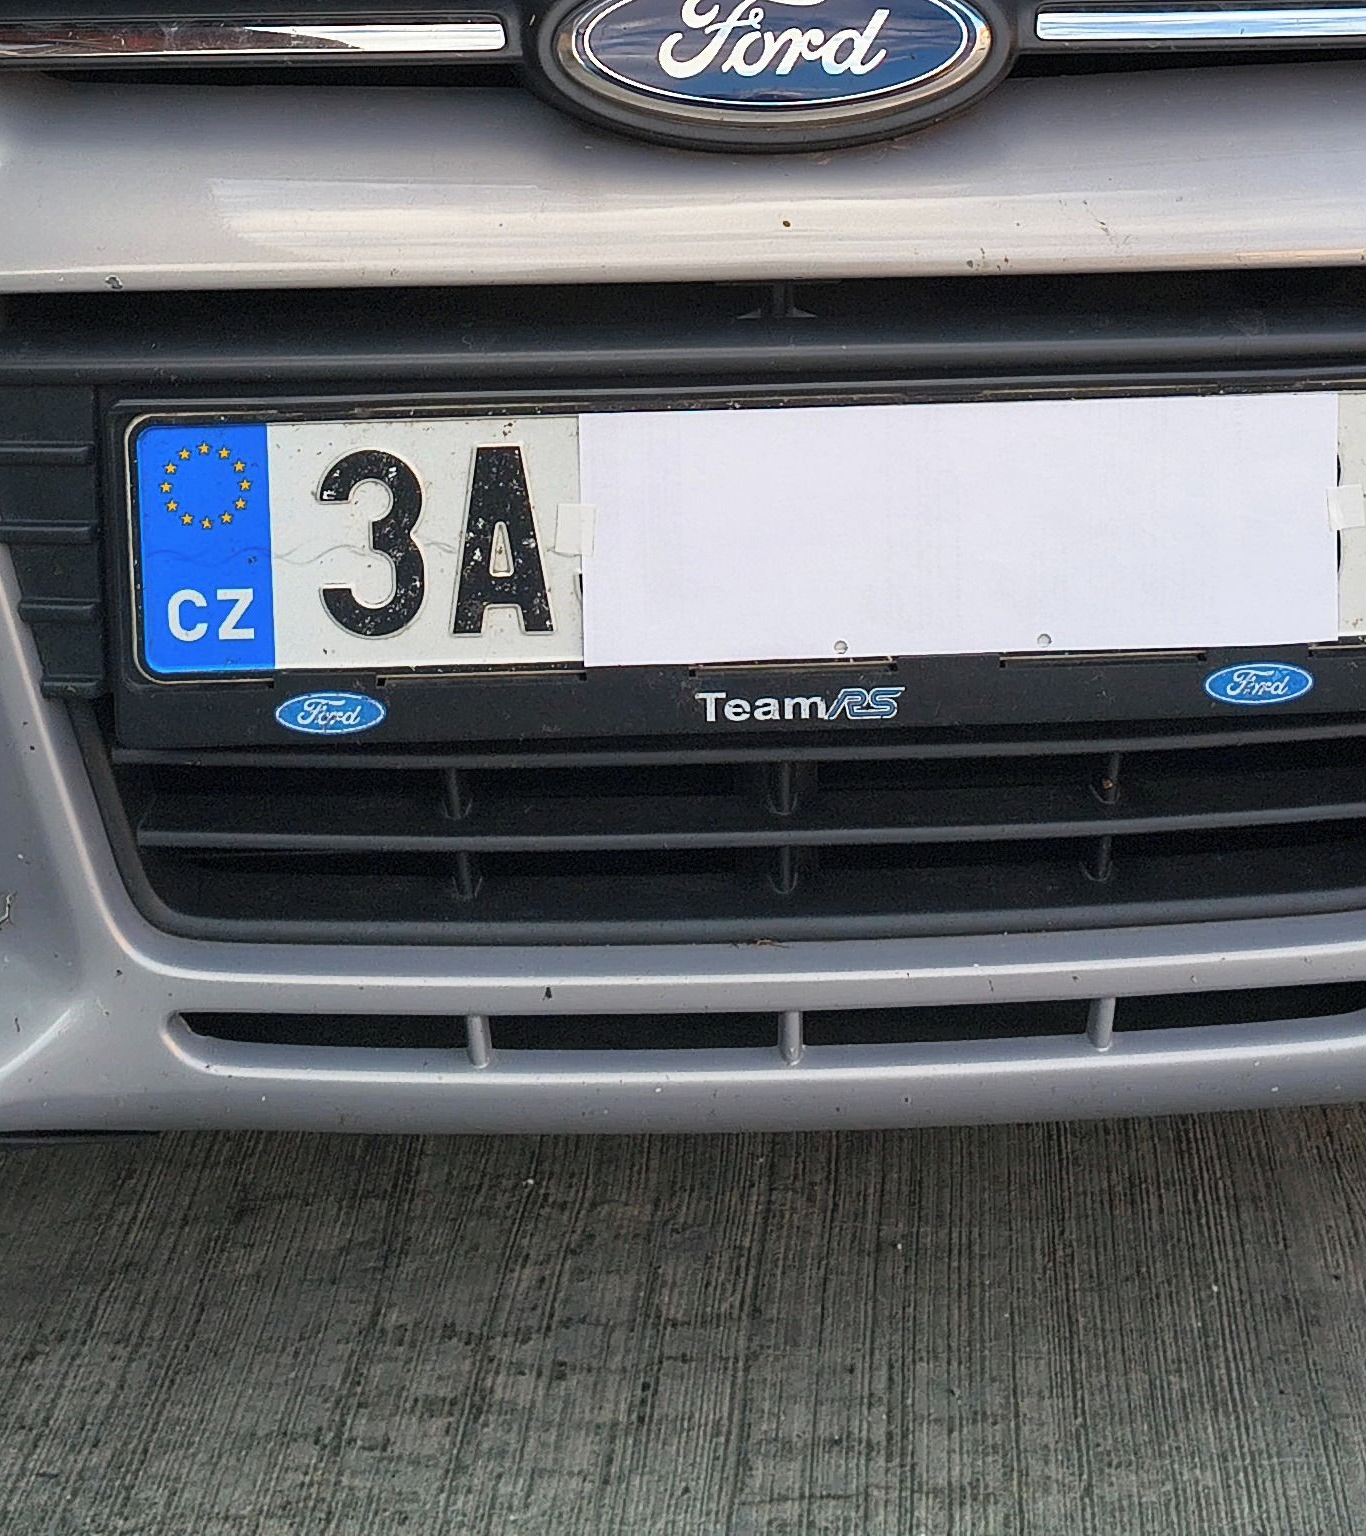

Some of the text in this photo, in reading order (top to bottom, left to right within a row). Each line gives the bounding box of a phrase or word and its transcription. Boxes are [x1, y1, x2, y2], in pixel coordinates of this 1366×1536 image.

[317, 445, 583, 640] 3A
[167, 587, 255, 642] CZ
[297, 698, 361, 724] Ford
